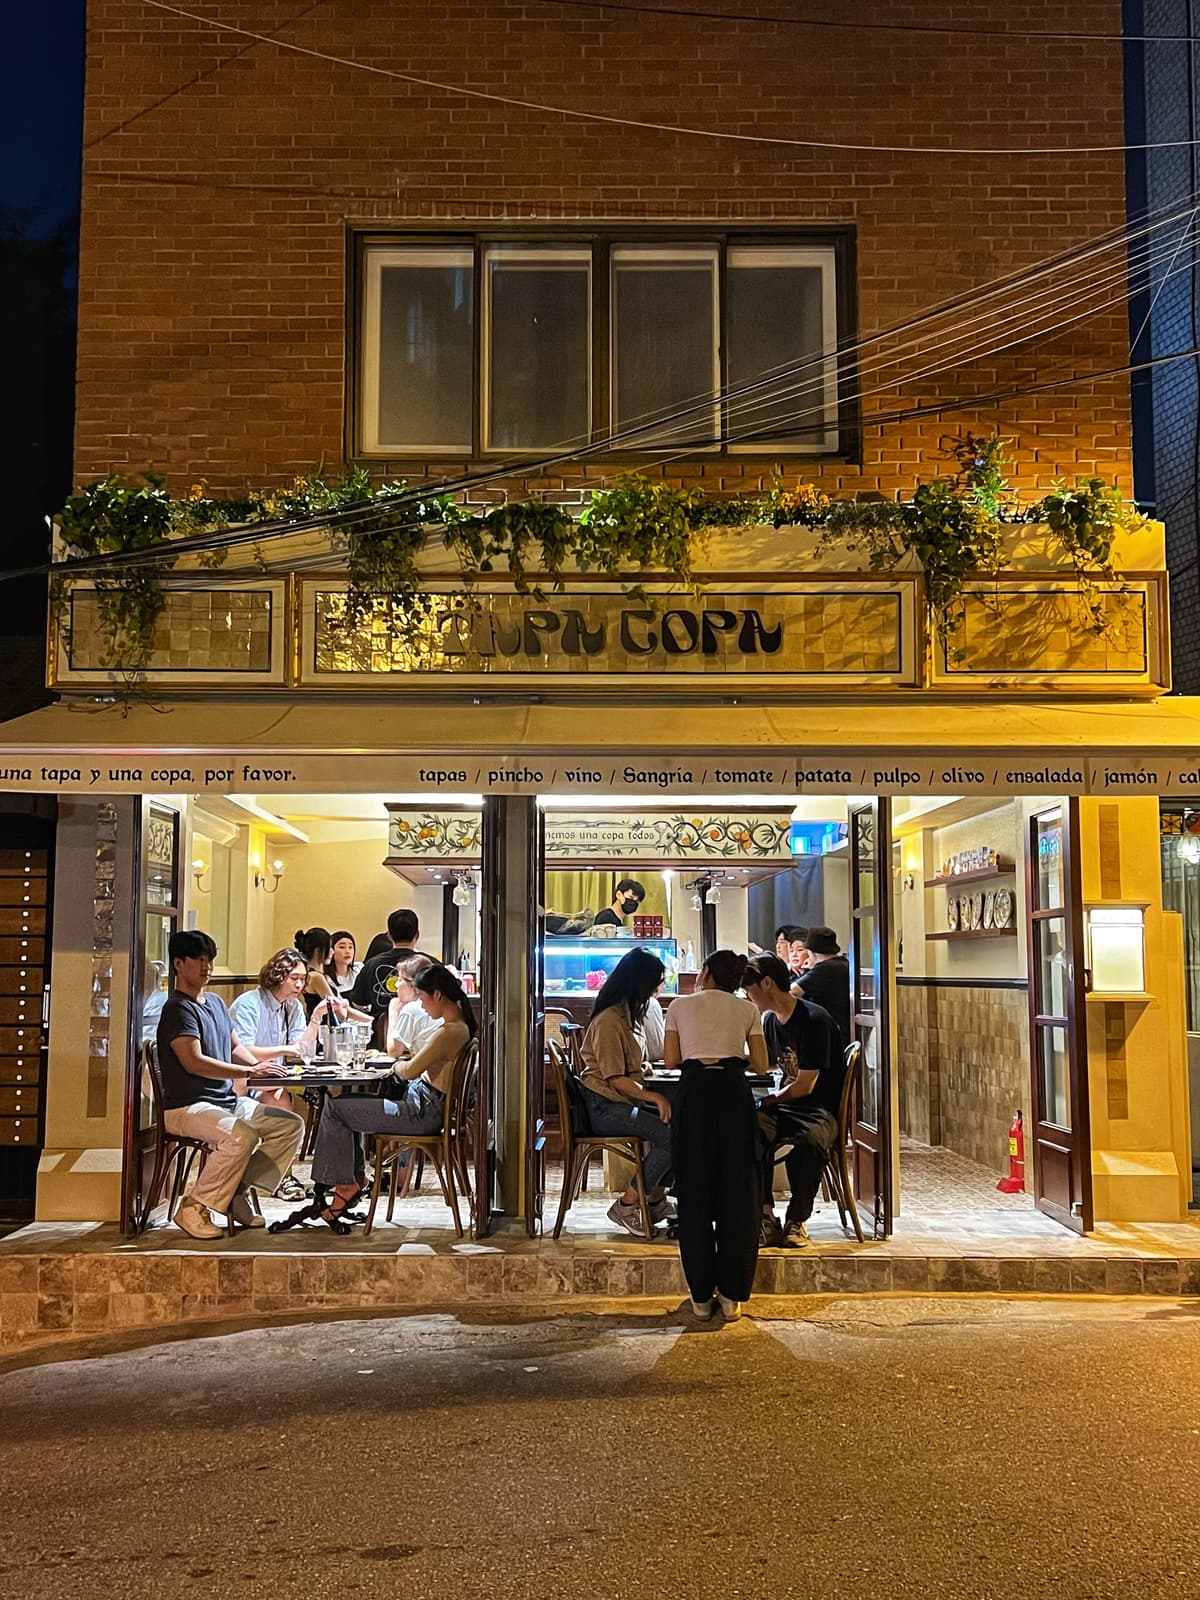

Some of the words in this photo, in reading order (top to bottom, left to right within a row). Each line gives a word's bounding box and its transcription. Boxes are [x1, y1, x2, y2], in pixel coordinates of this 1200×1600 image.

[437, 610, 606, 656] TAPA
[620, 609, 782, 655] COPA
[0, 768, 32, 780] una
[40, 767, 81, 785] tapa
[89, 769, 101, 785] y
[109, 769, 142, 781] una
[150, 769, 195, 786] copa,
[204, 769, 234, 786] por
[242, 765, 296, 781] favor.
[419, 768, 467, 786] tapas
[488, 766, 544, 786] pincho
[565, 767, 602, 783] vino
[714, 769, 774, 783] tomate
[794, 769, 852, 787] patata
[873, 767, 921, 788] pulpo
[1006, 767, 1083, 784] ensalada
[1104, 767, 1158, 789] jamón
[579, 832, 598, 840] una
[601, 832, 625, 842] copa
[628, 830, 655, 840] todos
